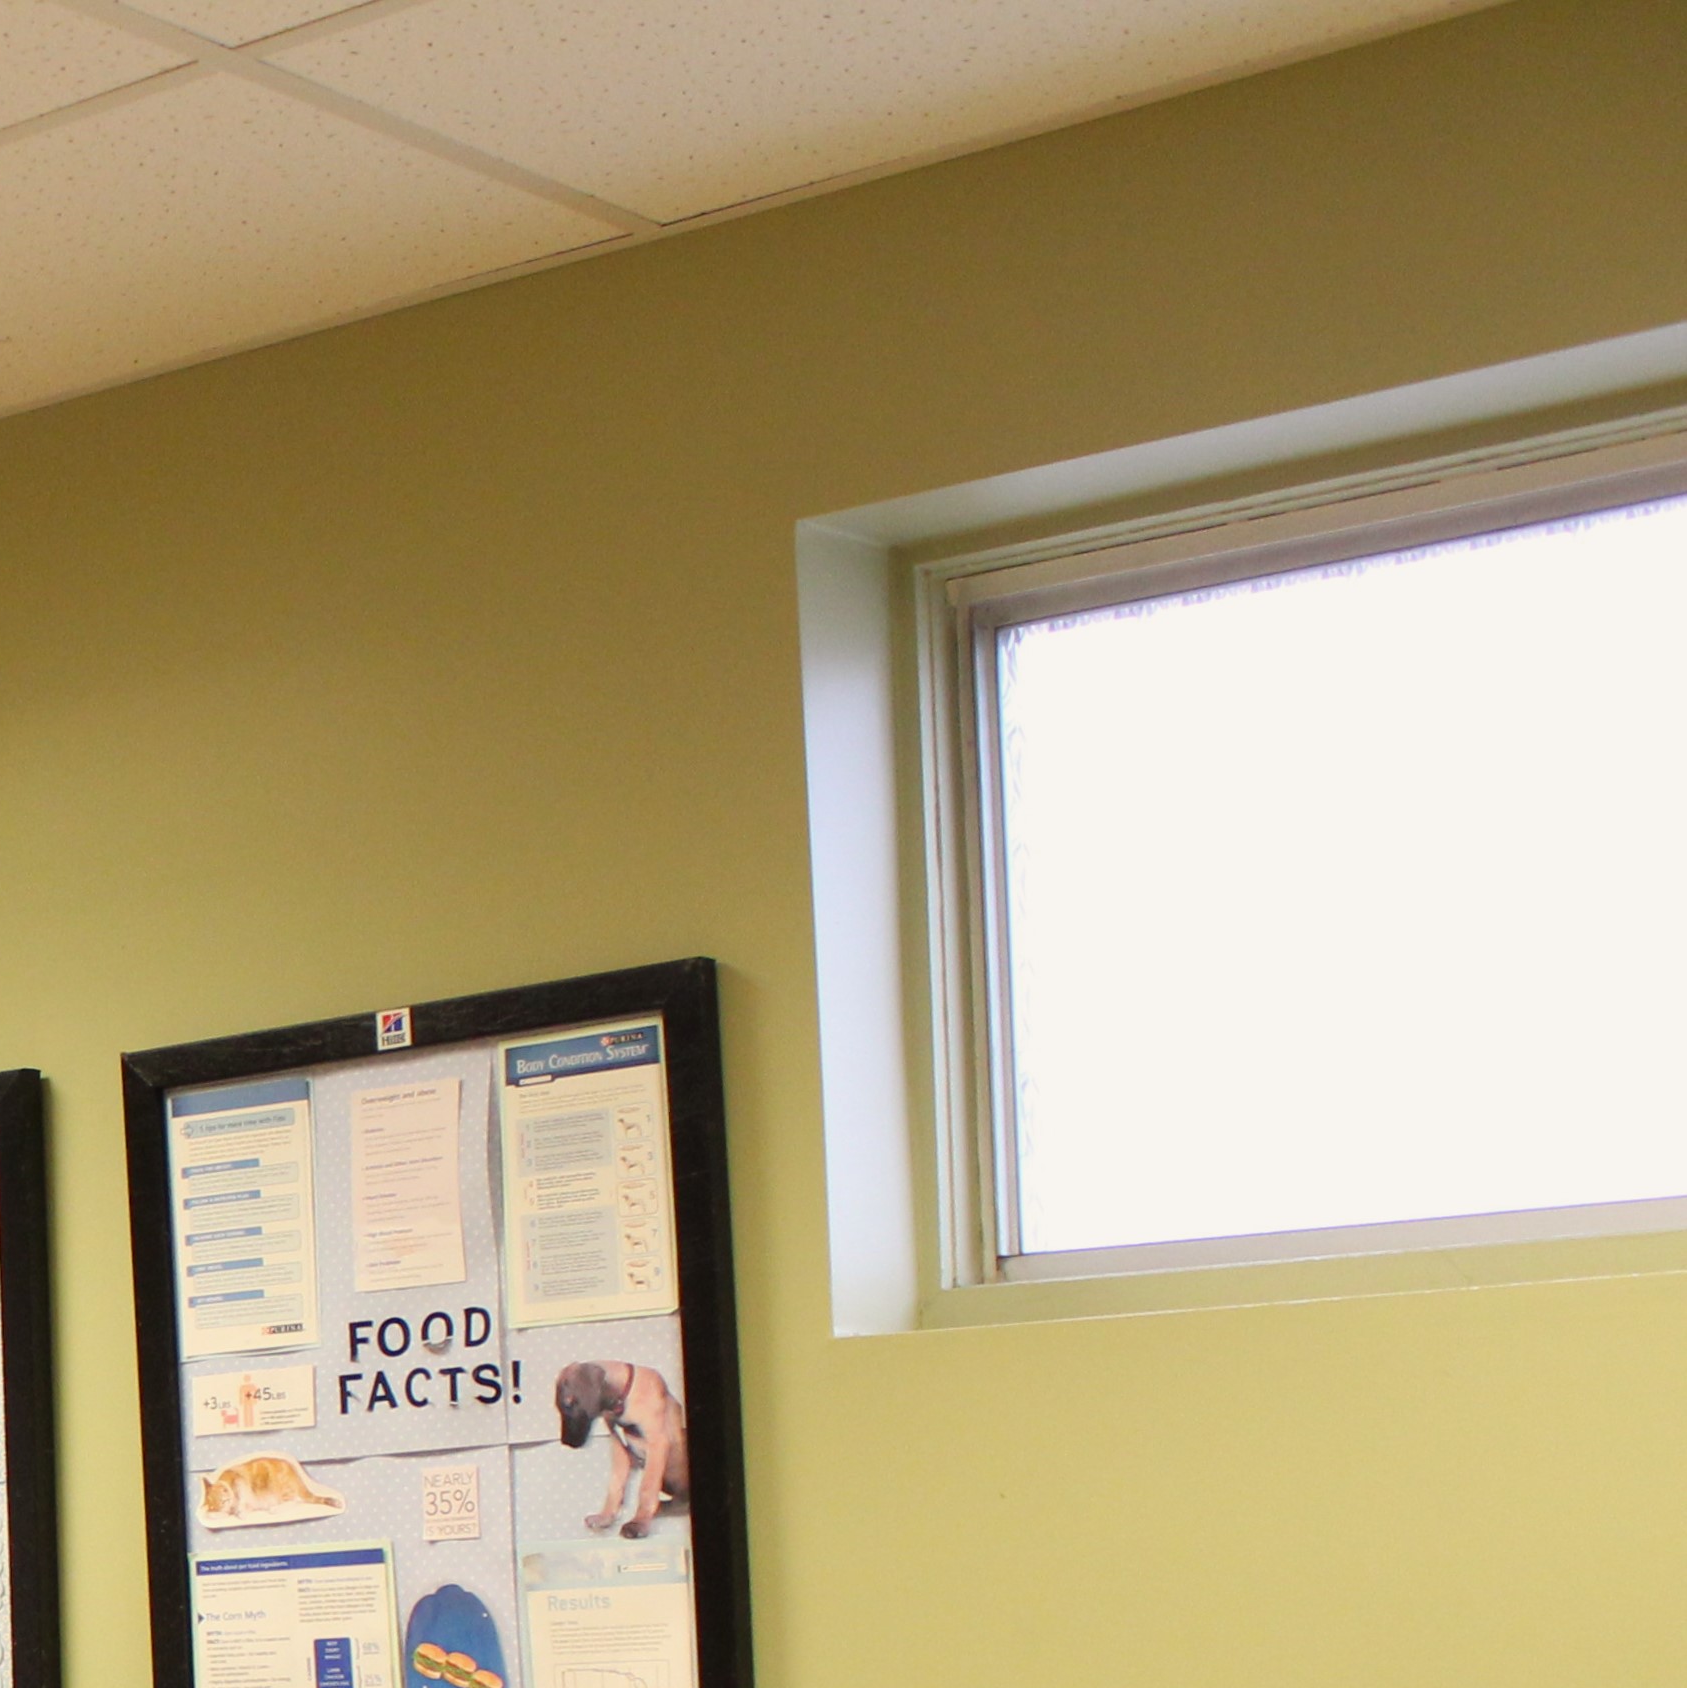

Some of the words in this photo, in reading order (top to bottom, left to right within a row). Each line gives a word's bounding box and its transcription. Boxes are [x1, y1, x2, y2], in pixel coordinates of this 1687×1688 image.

[349, 1307, 491, 1363] FOOD
[339, 1360, 522, 1415] FACTS!
[425, 1472, 474, 1488] NEARLY
[425, 1489, 475, 1516] 35%
[547, 1594, 612, 1612] Results
[206, 1612, 221, 1622] The
[222, 1611, 242, 1621] Corn
[244, 1610, 266, 1622] Myth
